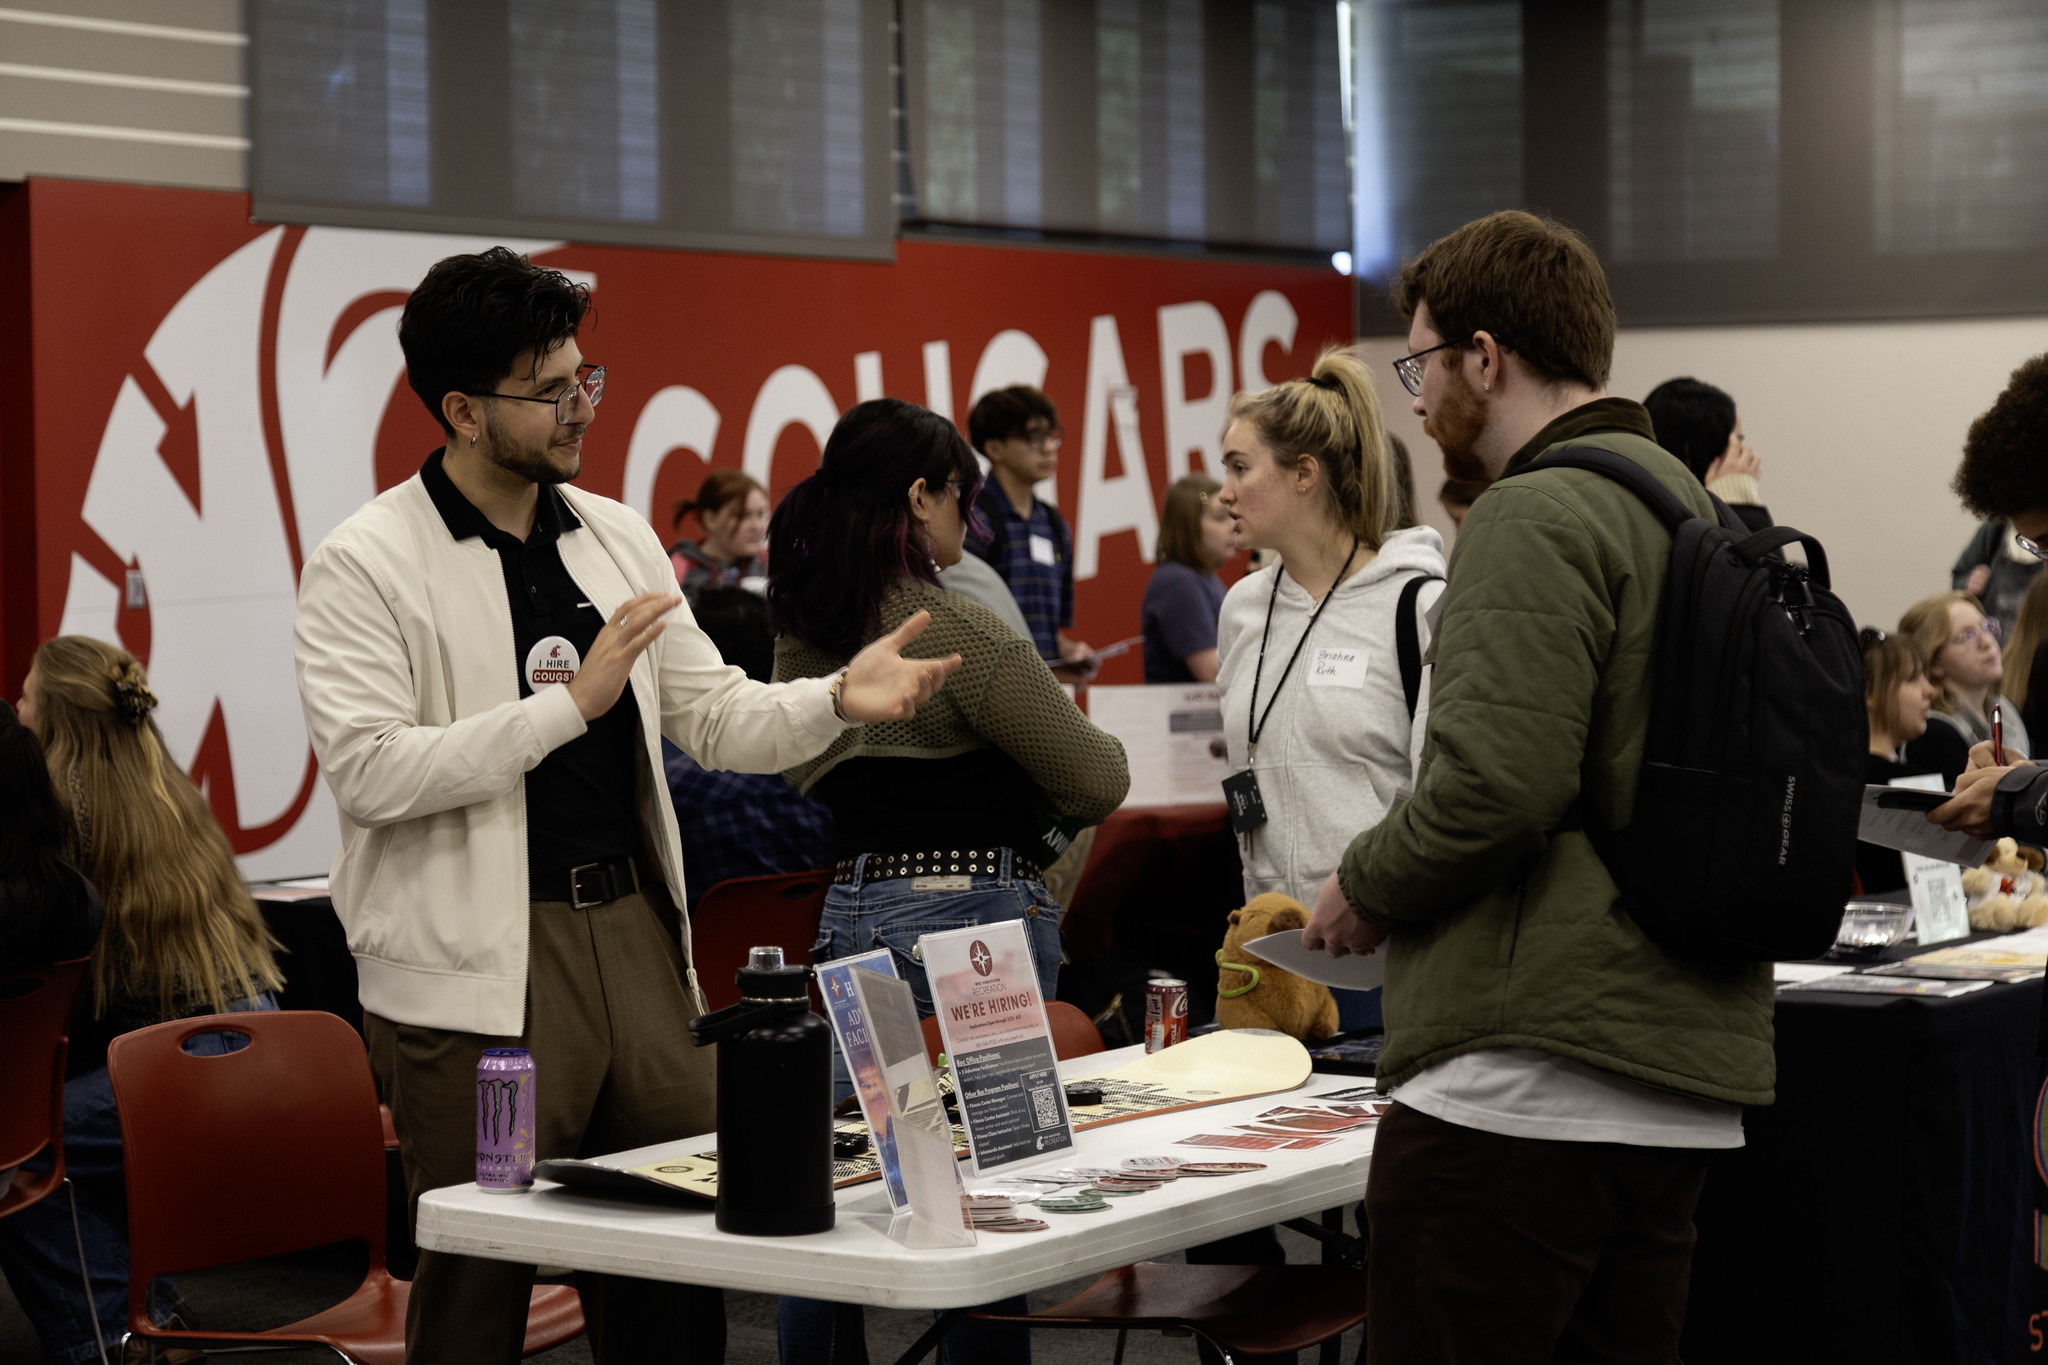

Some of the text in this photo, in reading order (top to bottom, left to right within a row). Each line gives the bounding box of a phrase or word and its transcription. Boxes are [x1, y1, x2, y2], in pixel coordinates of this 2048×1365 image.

[538, 659, 570, 669] I HIRE
[533, 671, 573, 682] COUGS!
[1778, 775, 1796, 865] SWISS GEAR
[971, 983, 1007, 997] RECREATION
[951, 991, 1032, 1022] WE'RE HIRING!
[2029, 1310, 2048, 1351] S
